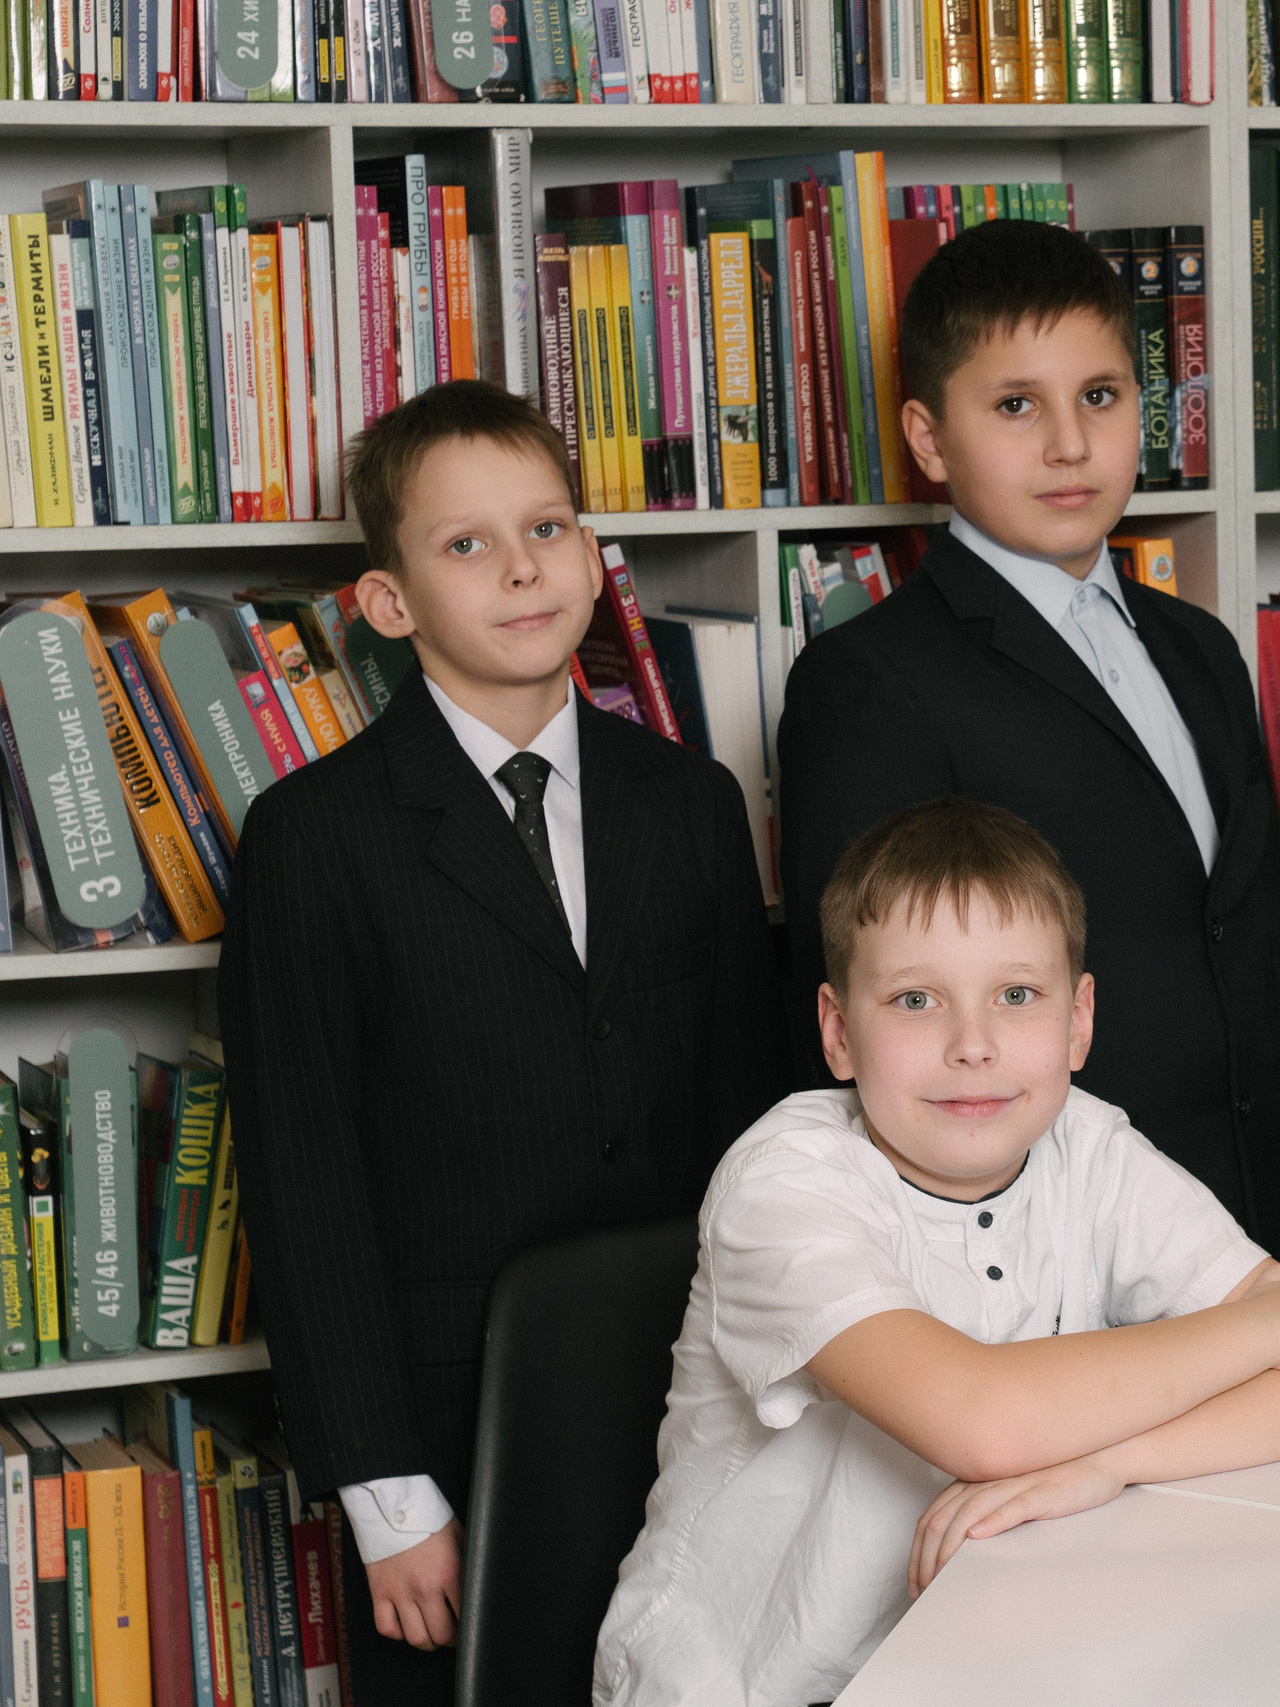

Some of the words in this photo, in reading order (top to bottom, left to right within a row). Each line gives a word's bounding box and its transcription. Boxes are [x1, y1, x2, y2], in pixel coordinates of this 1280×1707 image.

[236, 30, 258, 59] 24
[452, 31, 474, 59] 26
[728, 1, 744, 83] ГЕОГРАФИЯ
[508, 136, 521, 173] МИР
[410, 165, 425, 206] ПРО
[413, 211, 428, 276] ГРИБЫ
[511, 182, 525, 259] ПОЗНАЮ
[100, 235, 110, 287] ЧЕЛОВЕКА
[112, 238, 122, 274] ЖИЗНИ
[128, 237, 139, 285] ОКЕАНАХ
[142, 238, 151, 274] ЖИЗНИ
[356, 239, 368, 295] ЖИВОТНЫЕ
[370, 239, 379, 277] РОССИИ
[434, 239, 444, 278] РОССИИ
[448, 239, 457, 272] ЯГОДЫ
[458, 238, 467, 272] ЯГОДЫ
[719, 238, 745, 309] ДАРРЕЛЛ
[808, 230, 819, 269] РОССИИ
[28, 234, 46, 328] ТЕРМИТЫ
[58, 263, 71, 310] ЖИЗНИ
[371, 279, 381, 310] КНИГИ
[436, 280, 445, 309] КНИГИ
[451, 287, 459, 319] ГРИБЫ
[461, 286, 470, 319] ГРИБЫ
[62, 316, 75, 363] НАШЕЙ
[103, 291, 115, 345] АНАТОМИЯ
[116, 279, 131, 367] ПРОИСХОЖДЕНИЕ
[132, 298, 143, 333] МОРЯХ
[145, 279, 157, 367] ПРОИСХОЖДЕНИЕ
[359, 310, 370, 359] РАСТЕНИЯ
[372, 312, 384, 355] КРАСНОЙ
[437, 312, 448, 354] КРАСНОЙ
[762, 298, 771, 352] животных
[814, 305, 826, 350] КРАСНОЙ
[222, 332, 235, 395] животные
[244, 321, 255, 397] Динозавры
[557, 286, 576, 444] ПРЕСМЫКАЮЩИЕСЯ
[723, 313, 749, 398] ДЖЕРАЛЬД
[764, 356, 773, 389] жизни
[37, 345, 54, 422] ШМЕЛИ
[66, 369, 80, 420] РИТМЫ
[362, 363, 373, 416] ЯДОВИТЫЕ
[375, 373, 385, 414] АСТЕНИЯ
[800, 363, 810, 405] СОСЕДИ
[1141, 330, 1171, 449] БОТАНИКА
[1181, 324, 1206, 444] ЗООЛОГИЯ
[72, 425, 82, 464] Иванов
[86, 388, 102, 467] НЕСКУЧНАЯ
[230, 398, 240, 465] Вымершие
[766, 402, 777, 453] вопросов
[802, 407, 813, 461] ЧЕЛОВЕКА
[74, 466, 88, 504] Сергей
[767, 456, 778, 480] 1000
[38, 627, 74, 701] НАУКИ
[137, 686, 159, 723] детей
[302, 687, 327, 723] РУКУ
[654, 688, 675, 735] ПОЛЕЗНЫЙ
[153, 725, 169, 748] для
[59, 706, 112, 866] ТЕХНИЧЕСКИЕ
[164, 750, 200, 826] Компьютер
[48, 763, 86, 872] ТЕХНИКА.
[175, 1082, 220, 1187] КОШКА
[94, 1089, 119, 1243] ЖИВОТНОВОДСТВО
[92, 1248, 124, 1318] 45/46
[155, 1254, 198, 1348] ВАША
[268, 1490, 294, 1636] ПЕТРУШЕВСКИЙ
[307, 1551, 322, 1623] Лихачев
[14, 1579, 30, 1629] РУСЬ
